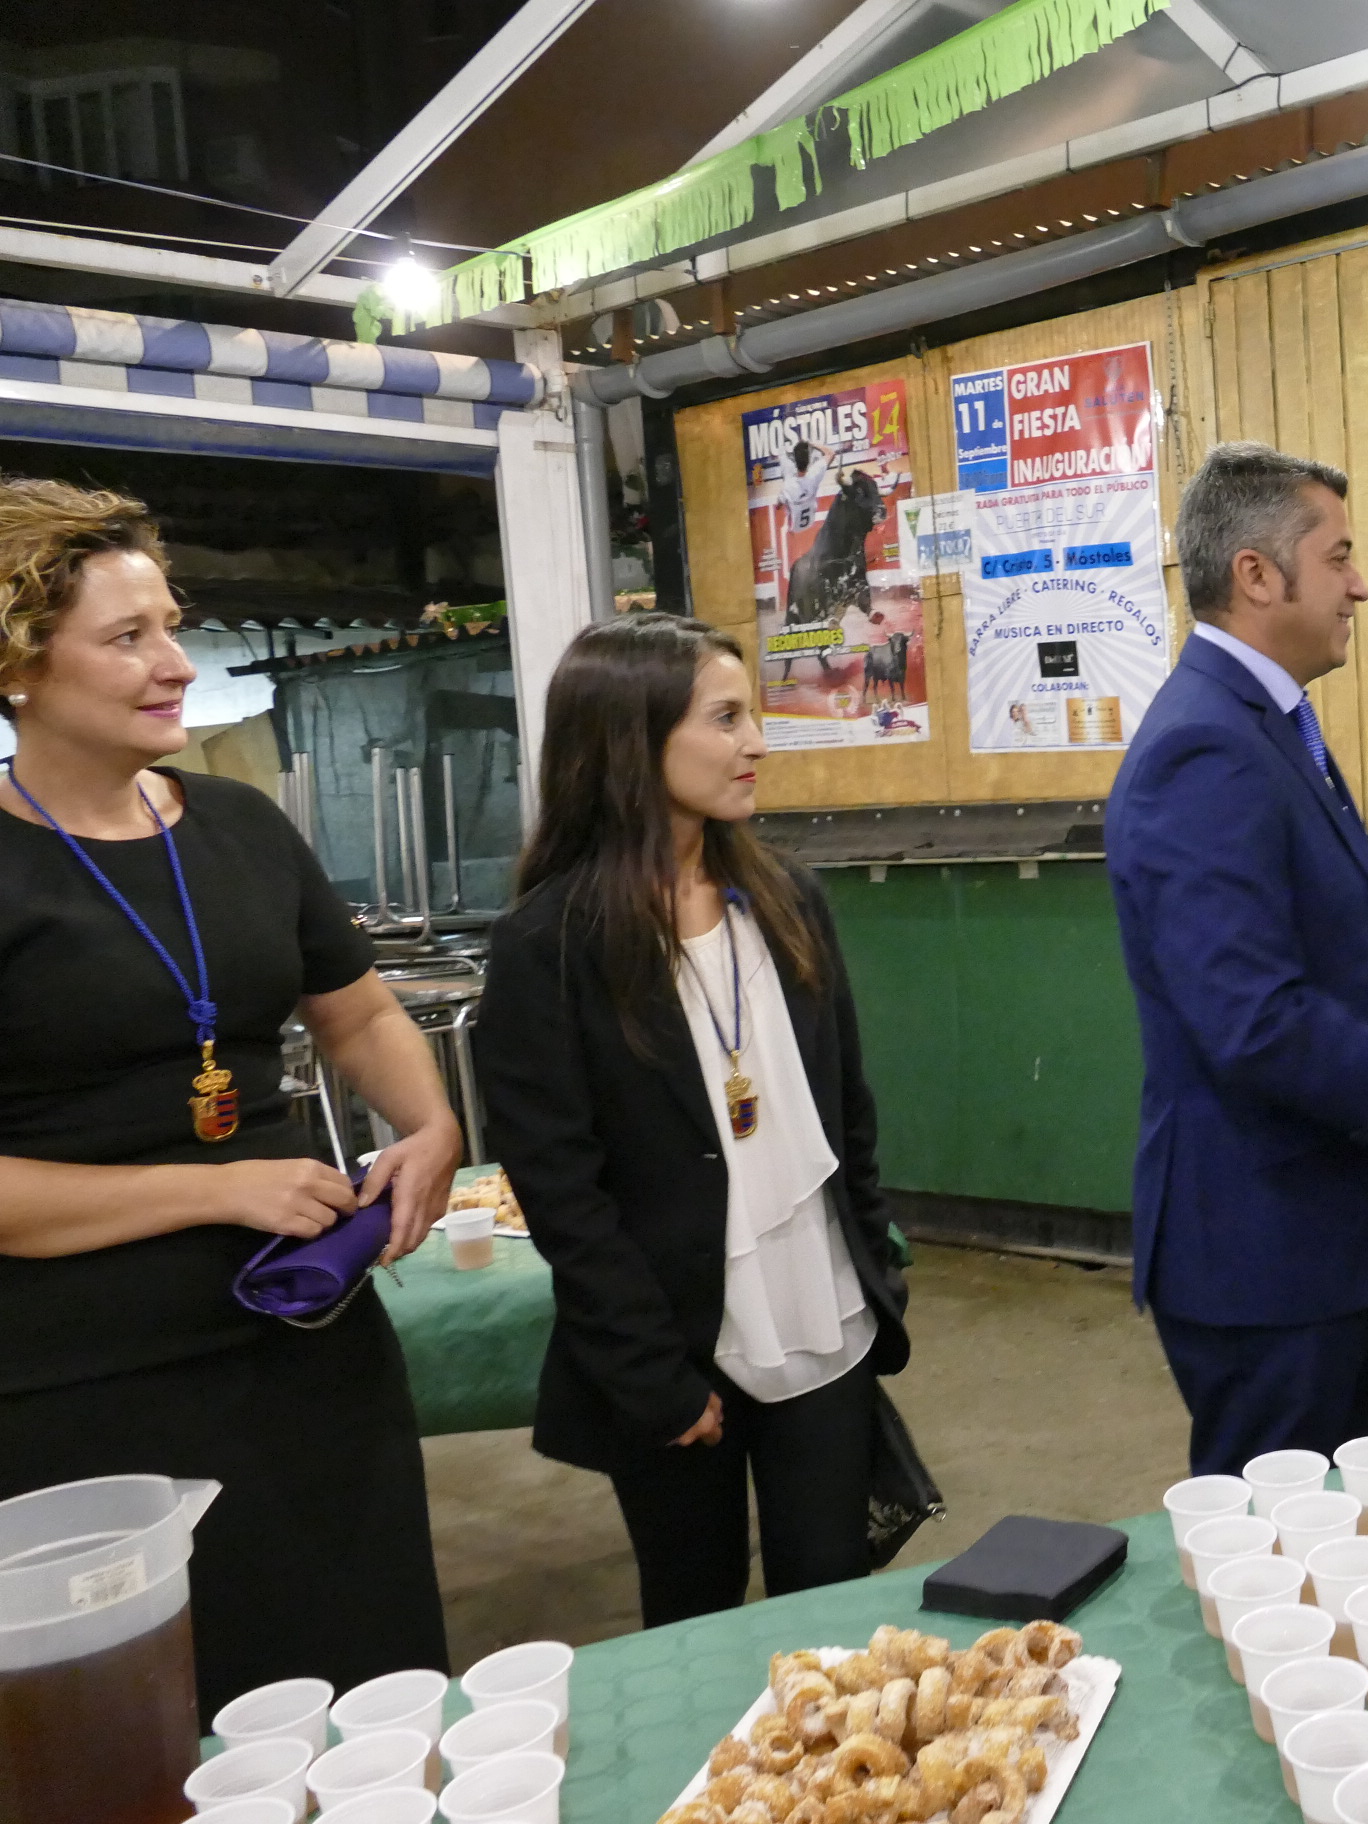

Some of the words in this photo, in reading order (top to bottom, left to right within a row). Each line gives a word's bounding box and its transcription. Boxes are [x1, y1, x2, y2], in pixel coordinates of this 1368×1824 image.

[954, 376, 1004, 397] MARTES
[1010, 365, 1071, 400] GRAN
[748, 401, 869, 460] MÓSTOLES
[957, 400, 986, 434] 11
[991, 418, 1004, 429] de
[1012, 404, 1082, 440] FIESTA
[958, 443, 1007, 461] Septiembre
[1041, 489, 1064, 500] PARA
[1066, 486, 1091, 497] TODO
[1094, 484, 1105, 494] EL
[1106, 480, 1149, 493] PÚBLICO
[1046, 506, 1073, 524] DEL
[1076, 502, 1105, 521] SUR
[983, 559, 997, 576] C/
[1066, 547, 1131, 566] Móstoles
[968, 613, 997, 657] BARRA
[997, 588, 1022, 616] LIBRE
[1031, 578, 1097, 594] CATERING
[1108, 590, 1163, 647] REGALOS
[1046, 623, 1063, 636] EN
[1067, 620, 1125, 635] DIRECTO
